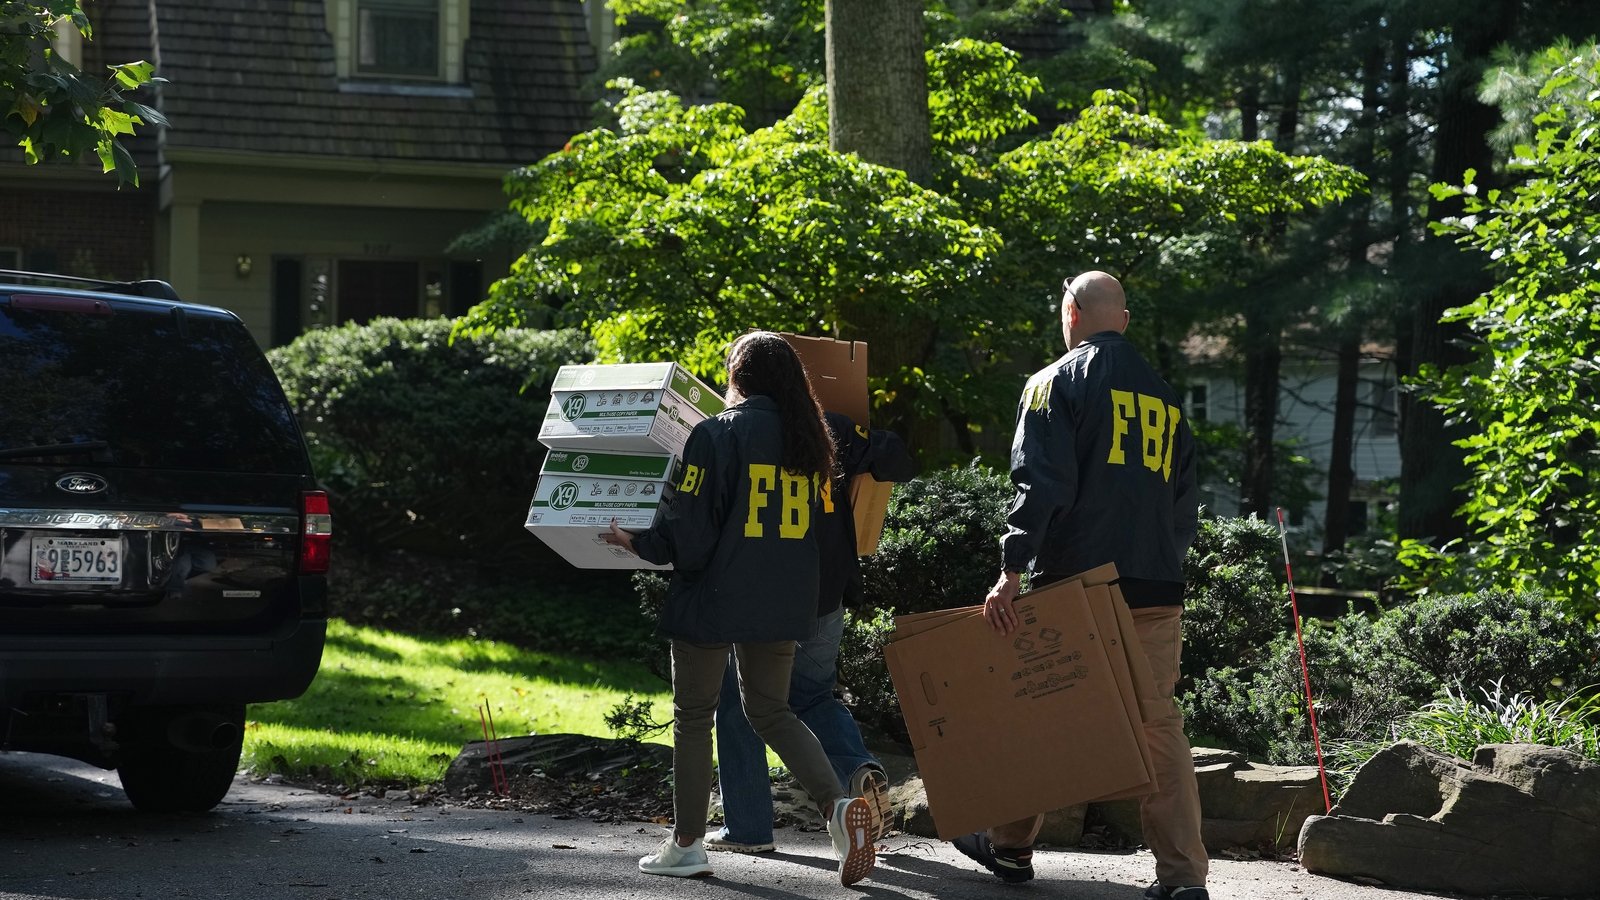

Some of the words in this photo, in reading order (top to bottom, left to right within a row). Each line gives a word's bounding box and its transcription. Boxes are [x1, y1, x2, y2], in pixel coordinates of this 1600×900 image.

[1107, 388, 1181, 483] FBI
[68, 477, 97, 490] Ford
[676, 464, 706, 496] BI
